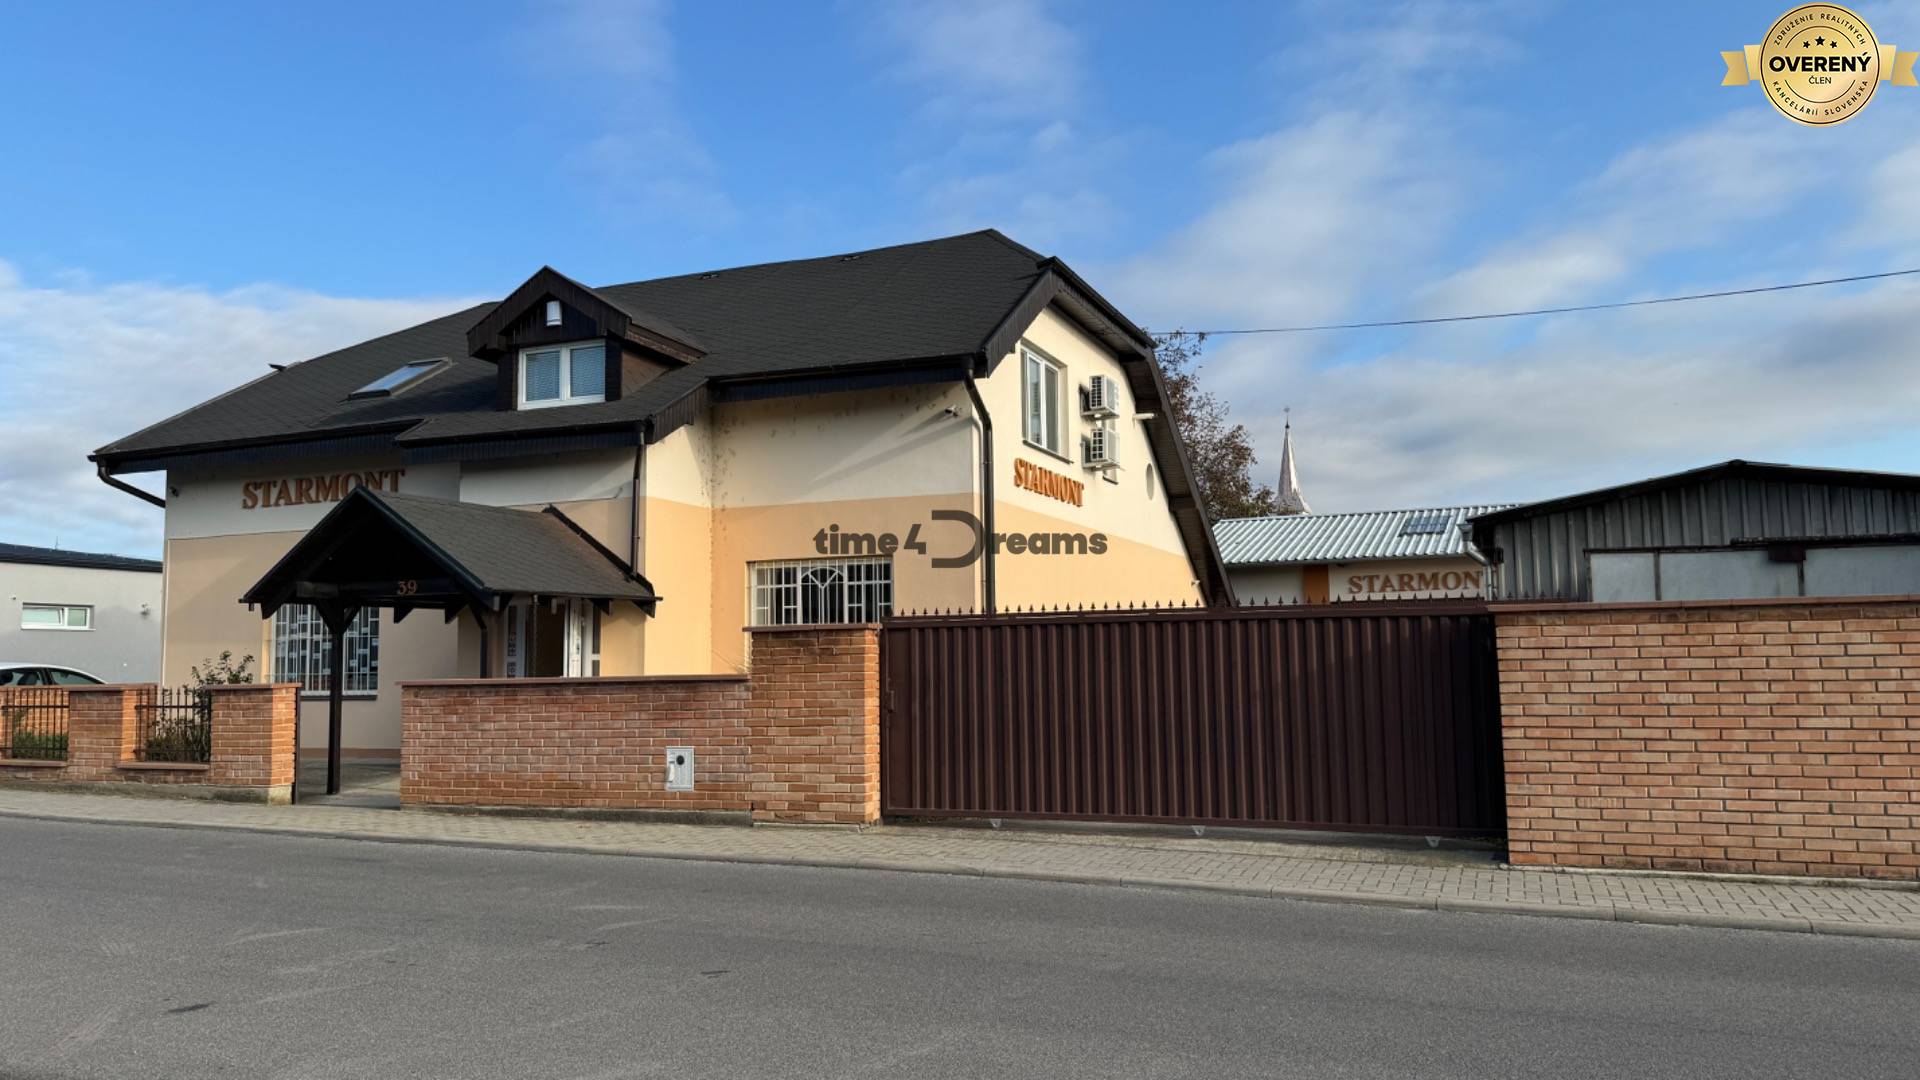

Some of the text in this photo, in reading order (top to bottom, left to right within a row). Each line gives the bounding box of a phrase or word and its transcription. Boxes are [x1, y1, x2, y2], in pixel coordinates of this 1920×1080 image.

[242, 468, 405, 509] STARMONT
[1014, 458, 1084, 507] STARMONT
[397, 580, 418, 595] 39
[1347, 569, 1484, 594] STARMON
